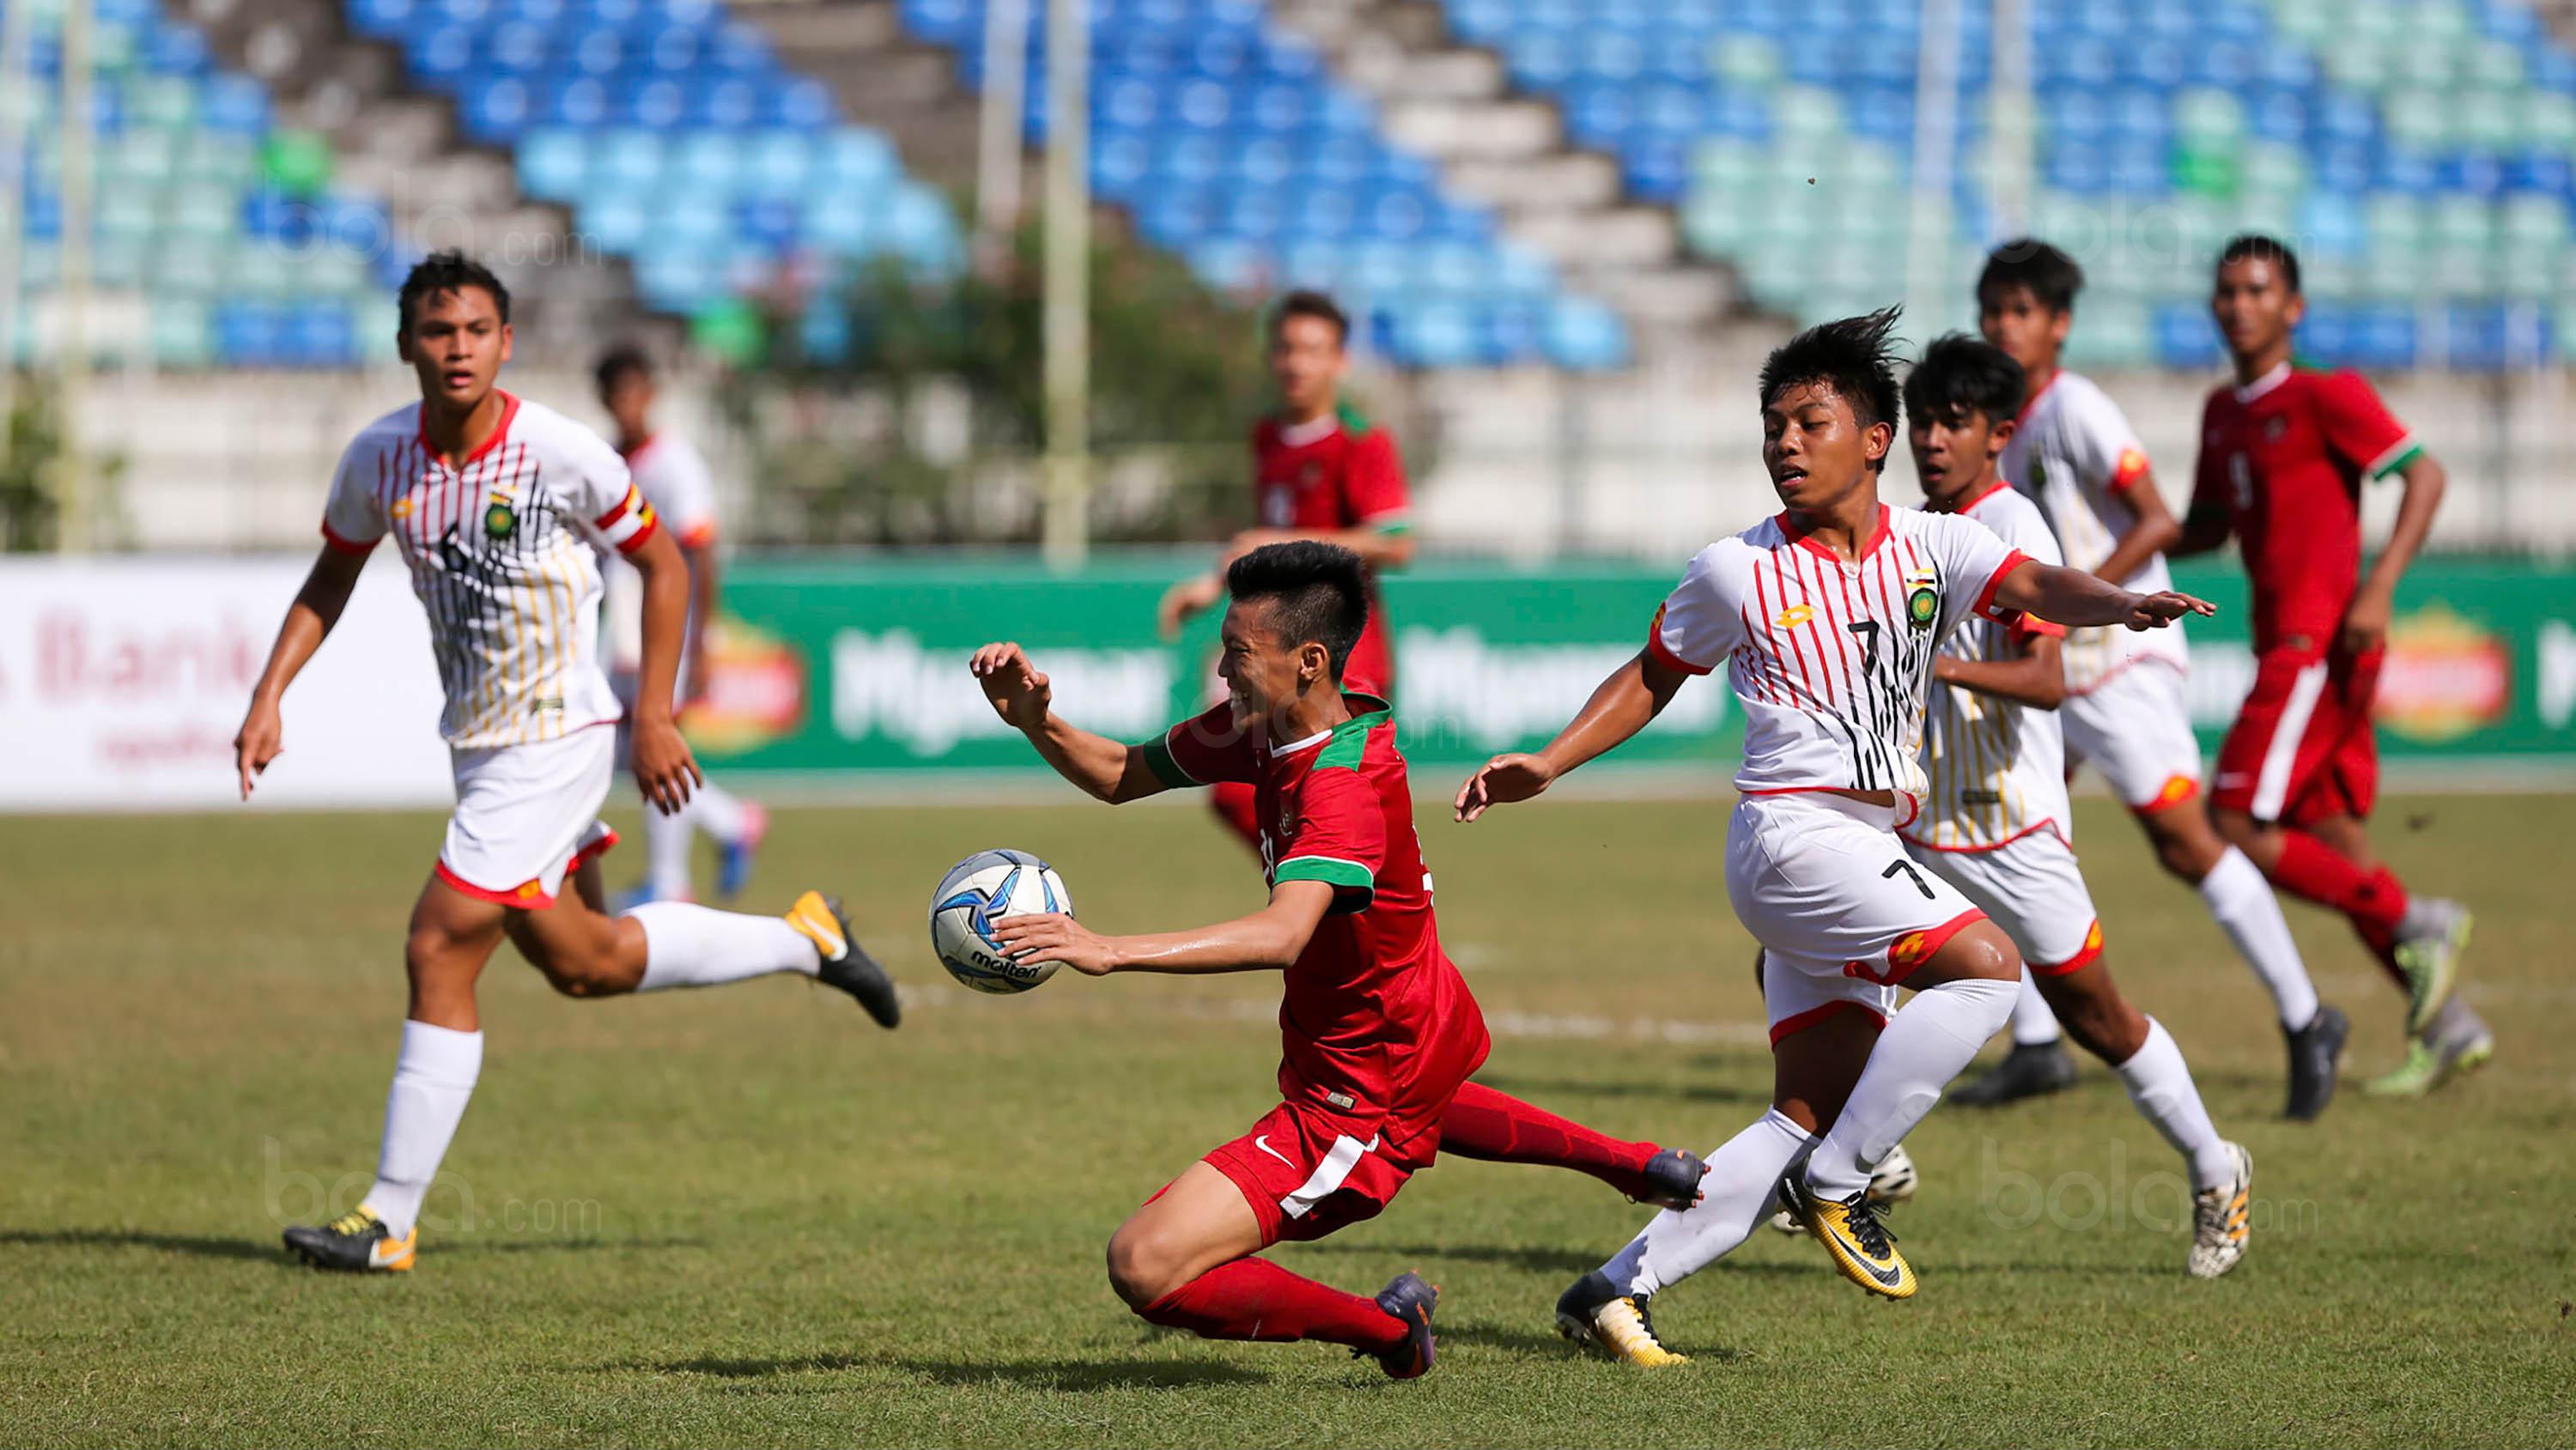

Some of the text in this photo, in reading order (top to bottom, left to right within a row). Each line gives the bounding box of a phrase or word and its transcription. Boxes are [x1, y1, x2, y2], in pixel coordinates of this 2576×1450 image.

[1848, 621, 1880, 676] 7
[1881, 859, 1935, 900] 7
[971, 950, 1041, 978] molten
